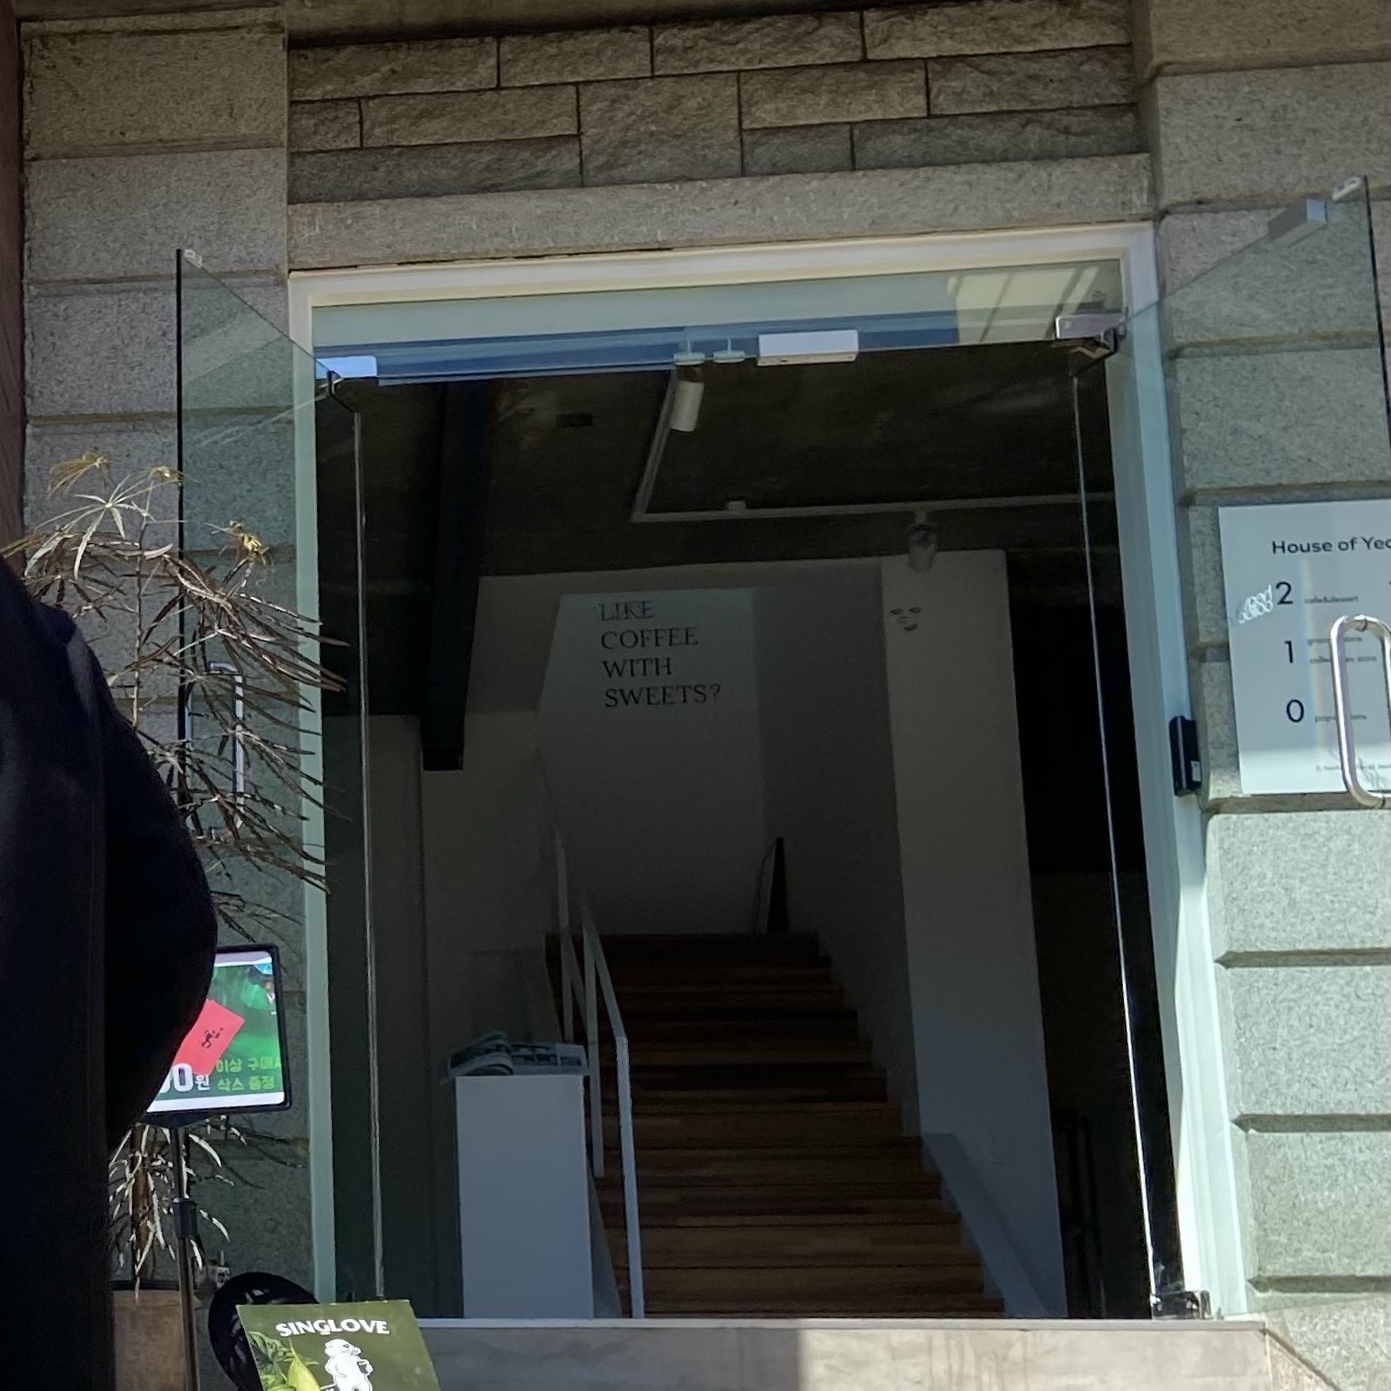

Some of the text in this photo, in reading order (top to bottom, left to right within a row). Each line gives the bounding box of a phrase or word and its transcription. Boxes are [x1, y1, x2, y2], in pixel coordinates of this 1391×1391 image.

[1272, 540, 1333, 554] House
[1338, 536, 1358, 551] of
[1275, 581, 1294, 605] 2
[597, 600, 656, 621] LIKE
[600, 626, 699, 650] COFFEE
[1284, 640, 1294, 664] 1
[602, 657, 672, 678] WITH
[604, 683, 722, 708] SWEETS?
[1285, 699, 1305, 723] 0
[215, 1057, 243, 1073] 이상
[217, 1077, 245, 1092] 삭스
[275, 1318, 390, 1337] SINGLOVE
